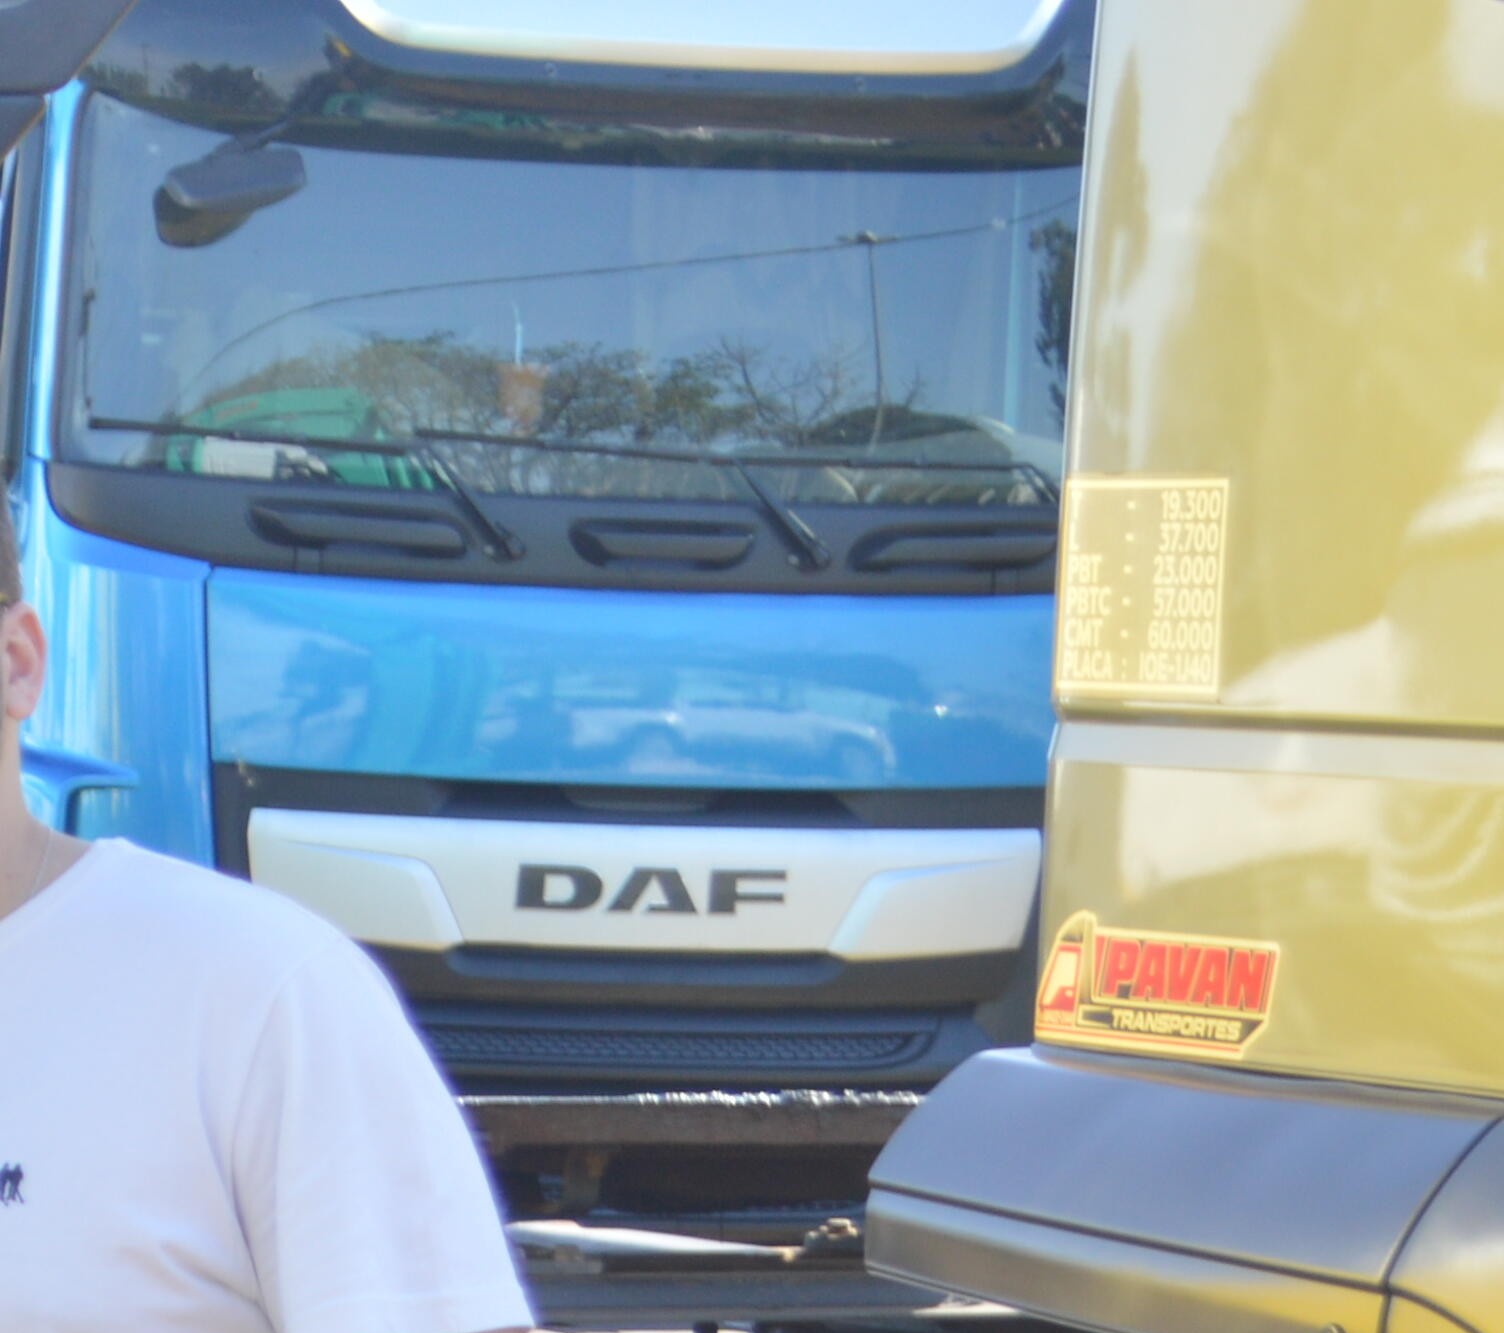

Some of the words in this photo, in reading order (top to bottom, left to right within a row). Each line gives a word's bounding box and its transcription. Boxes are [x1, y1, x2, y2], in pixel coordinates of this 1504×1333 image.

[1161, 490, 1221, 520] 19.300
[1069, 522, 1080, 551] L
[1159, 522, 1219, 552] 37.700
[1067, 554, 1103, 583] PBT
[1153, 555, 1217, 584] 23.000
[1065, 586, 1112, 616] PBTC
[1153, 587, 1215, 617] 57.000
[1064, 618, 1104, 647] CMT
[1147, 619, 1212, 650] 60.000
[1062, 650, 1113, 680] PLACA
[514, 862, 787, 915] DAF
[1102, 938, 1269, 1010] PAVAN
[1111, 1008, 1243, 1042] TRANSPORTES
